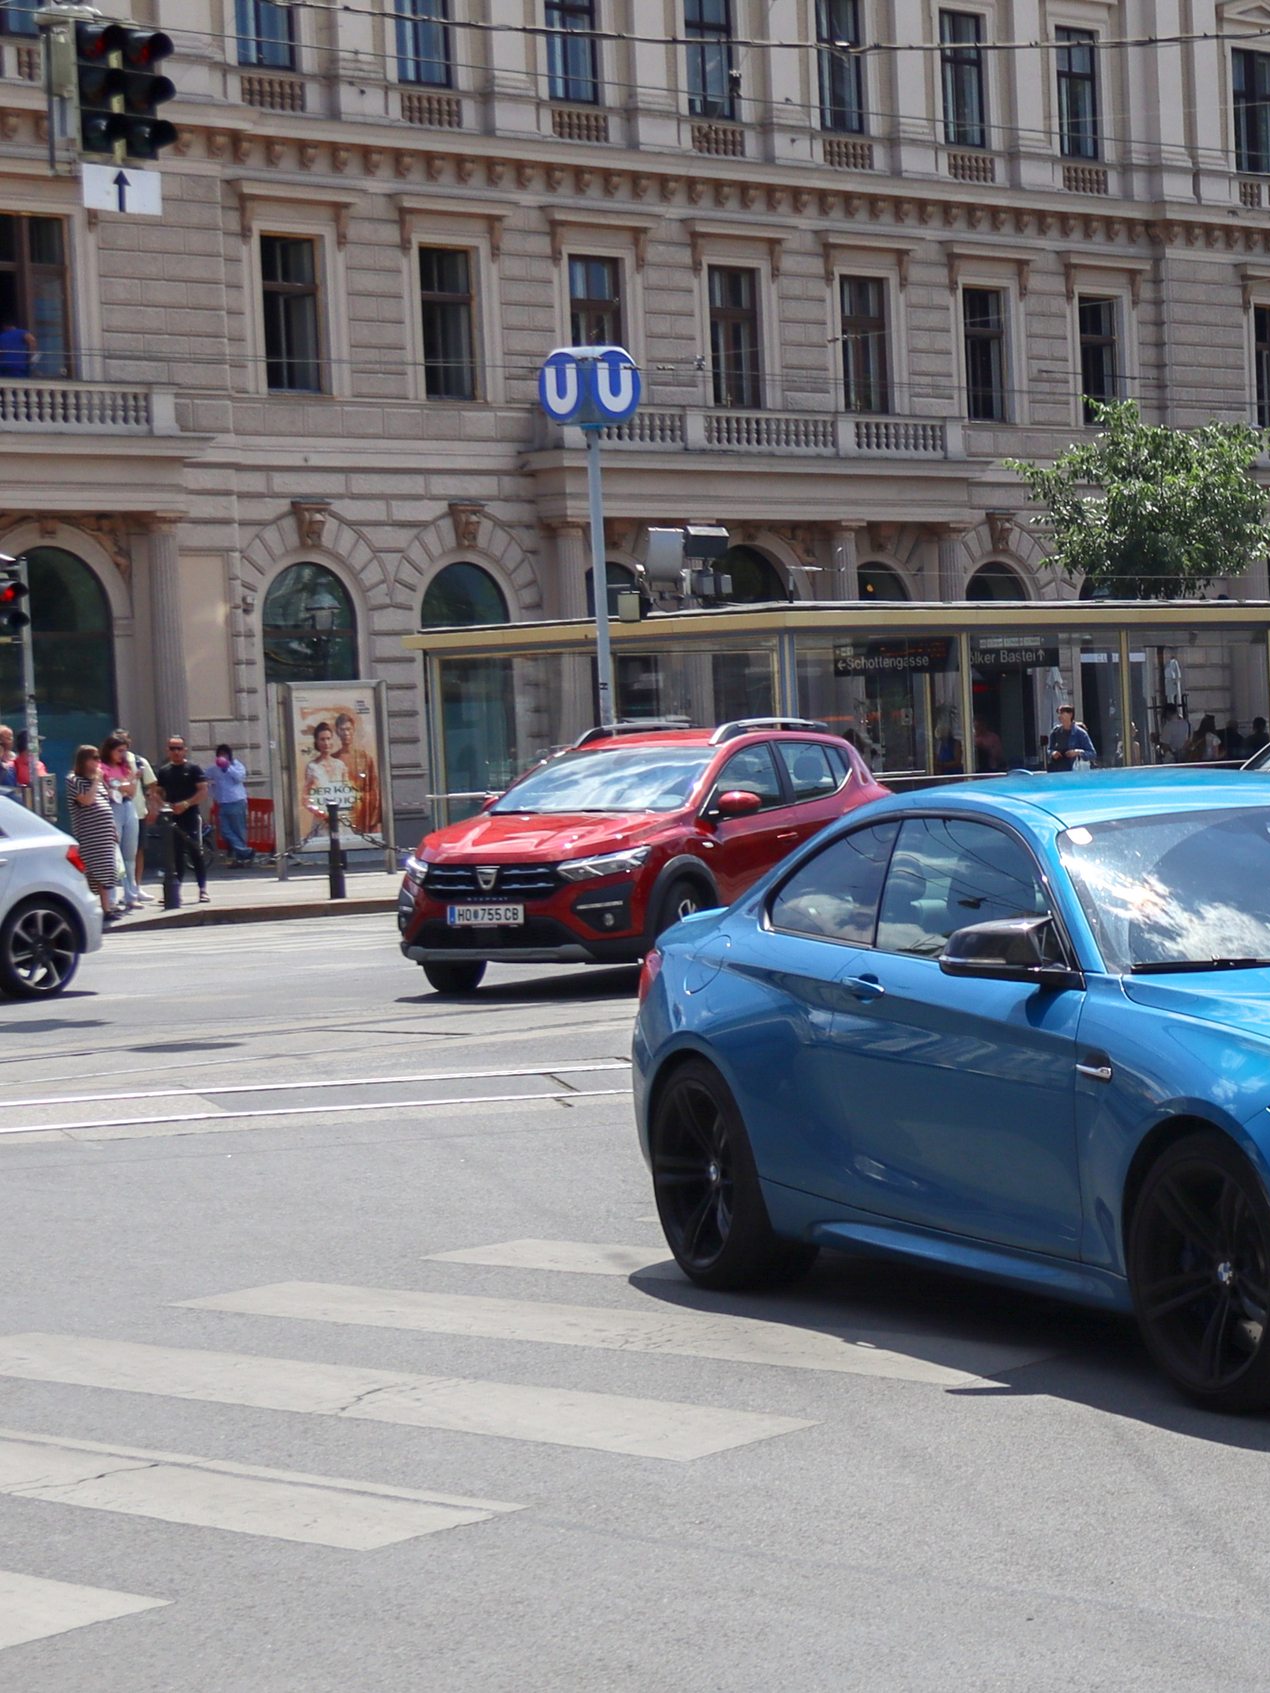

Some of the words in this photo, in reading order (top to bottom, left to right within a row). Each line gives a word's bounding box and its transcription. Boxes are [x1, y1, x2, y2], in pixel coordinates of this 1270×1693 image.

[544, 363, 578, 415] U
[596, 362, 634, 413] U
[846, 655, 930, 670] Schottengasse
[1000, 649, 1037, 664] Bastei
[308, 787, 332, 796] DER
